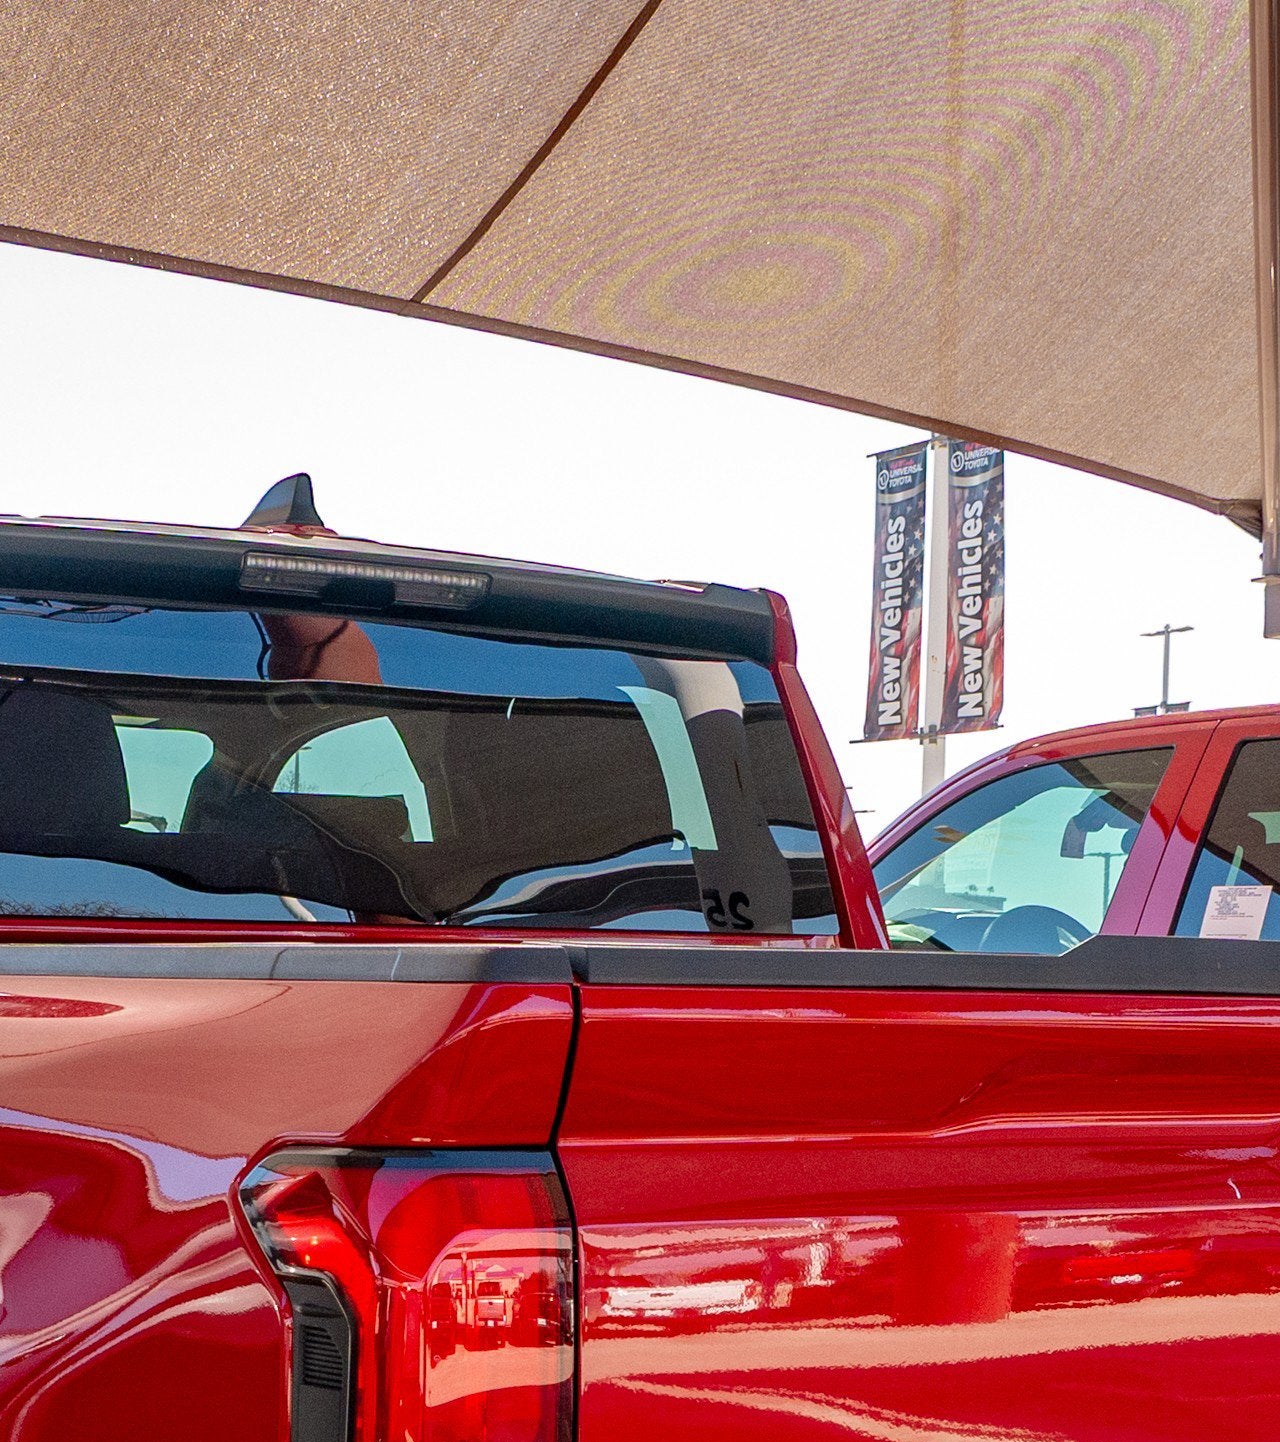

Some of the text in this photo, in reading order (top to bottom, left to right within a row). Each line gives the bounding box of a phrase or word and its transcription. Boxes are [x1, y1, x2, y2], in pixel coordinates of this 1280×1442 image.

[964, 457, 989, 470] TOYOTA
[889, 464, 923, 478] UNIVERSAL
[889, 475, 912, 488] TOYOTA
[957, 499, 983, 718] New Vehicles
[878, 514, 905, 726] New Vehicles
